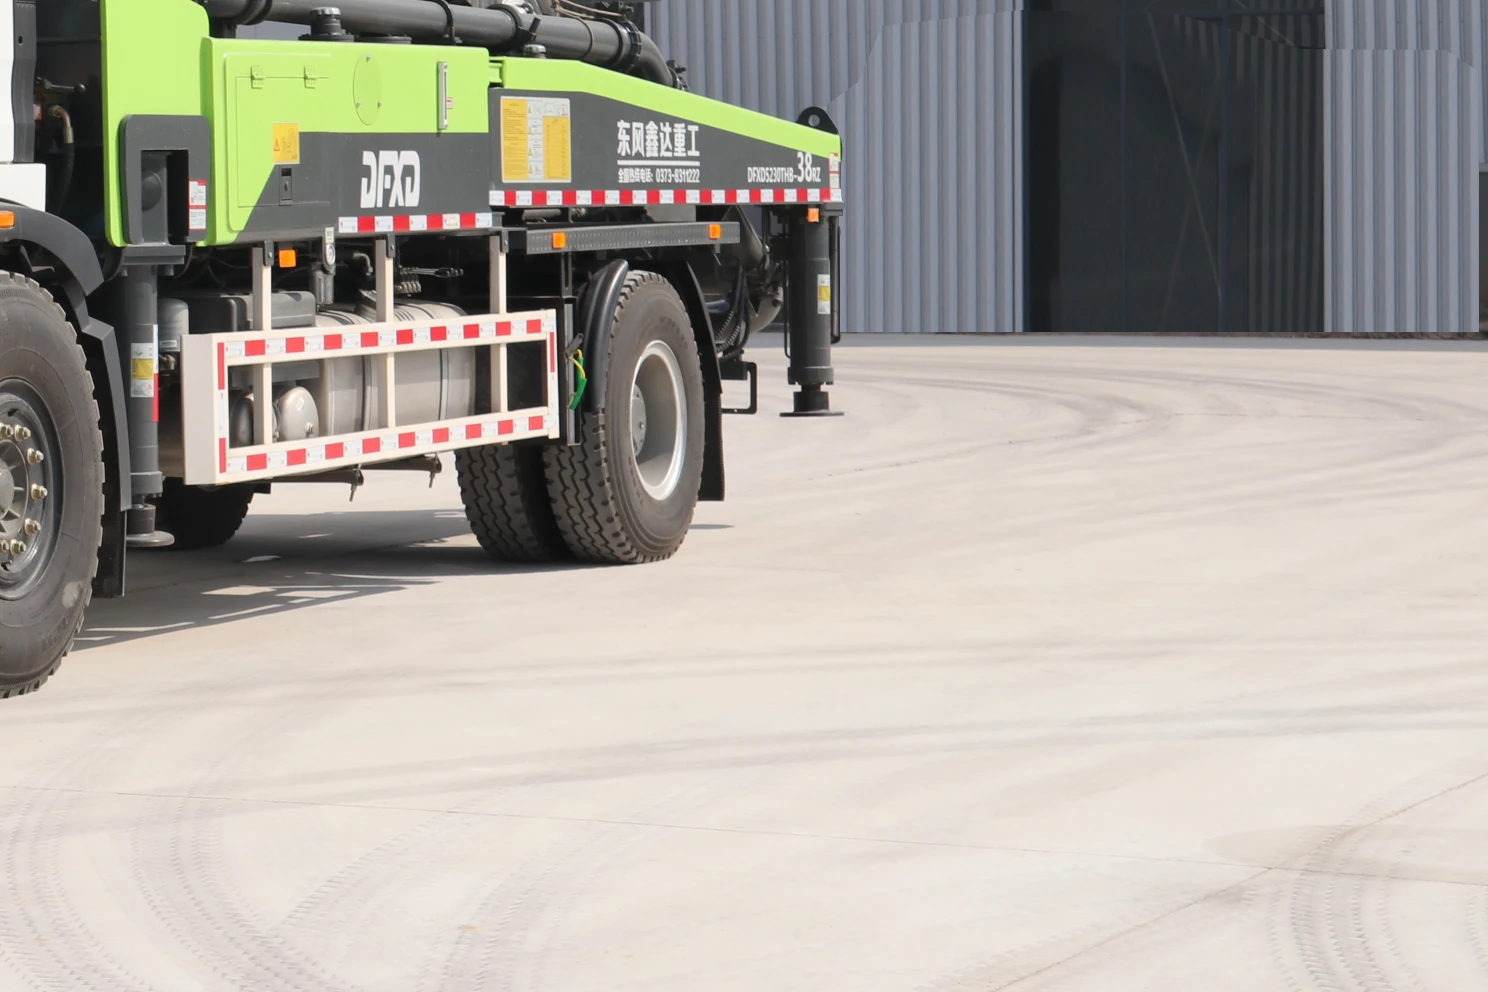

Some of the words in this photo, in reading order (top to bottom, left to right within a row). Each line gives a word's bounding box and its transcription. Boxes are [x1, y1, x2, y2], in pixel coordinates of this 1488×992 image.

[616, 119, 701, 157] 东风鑫达重工
[360, 150, 421, 208] DFXD
